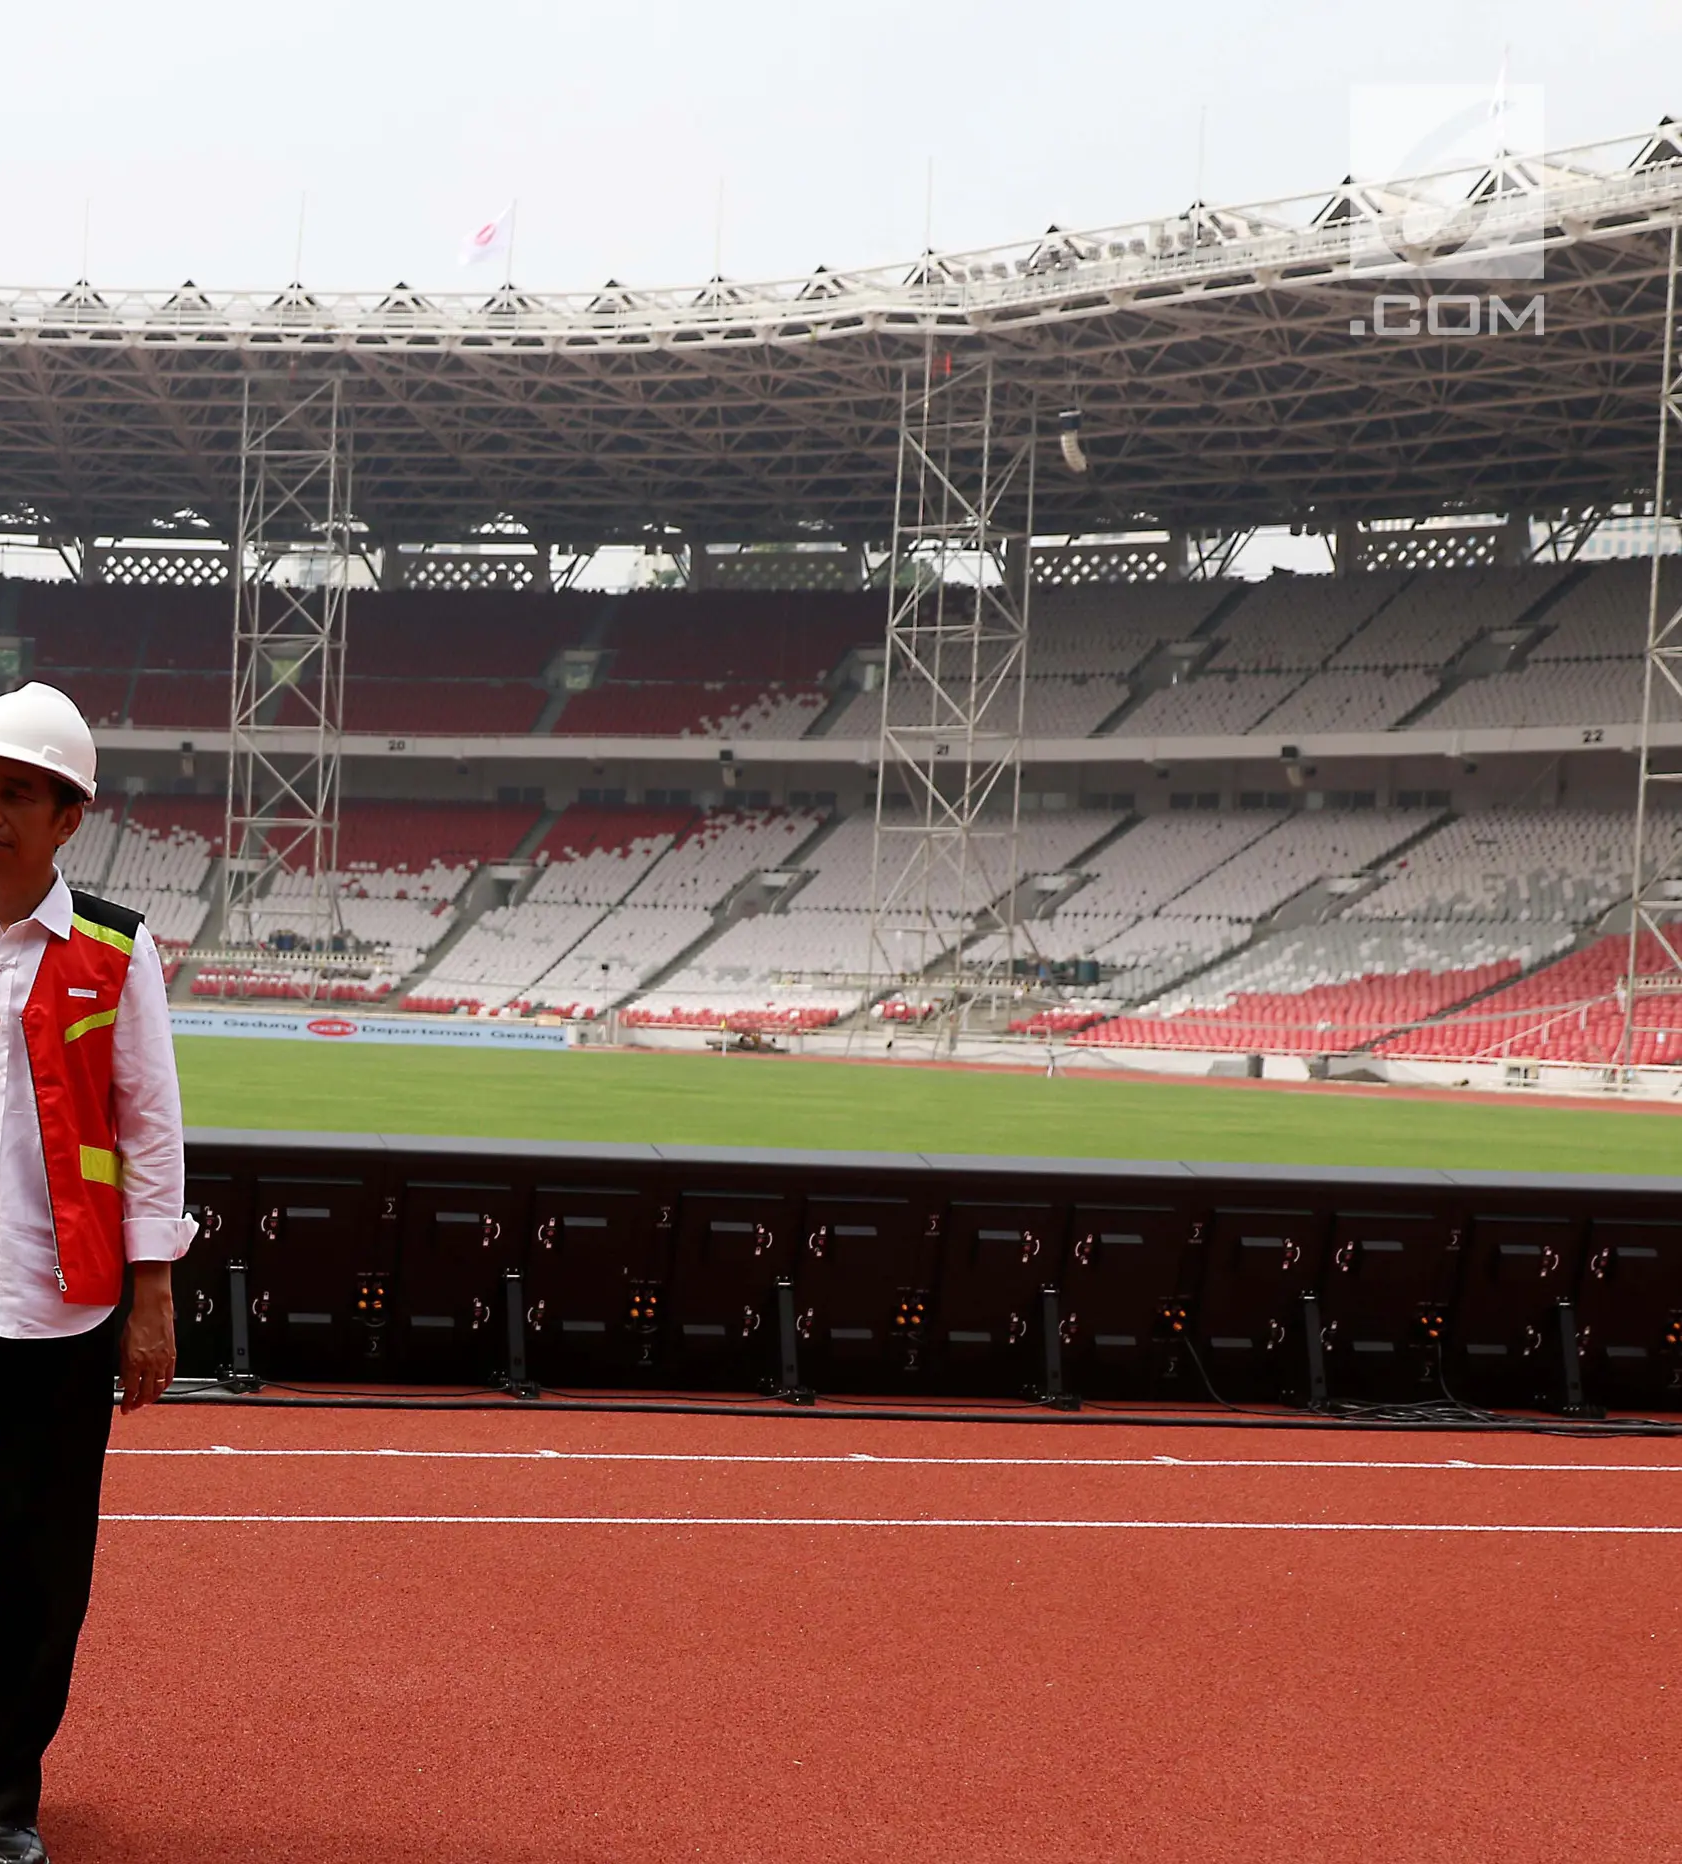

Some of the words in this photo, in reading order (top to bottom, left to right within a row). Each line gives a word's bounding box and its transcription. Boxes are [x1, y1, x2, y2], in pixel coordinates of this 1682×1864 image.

[1582, 728, 1605, 743] 22
[388, 740, 405, 751] 20
[935, 743, 949, 755] 21
[223, 1018, 298, 1032] Gedung
[362, 1025, 481, 1039] Departemen
[490, 1029, 565, 1043] Gedung
